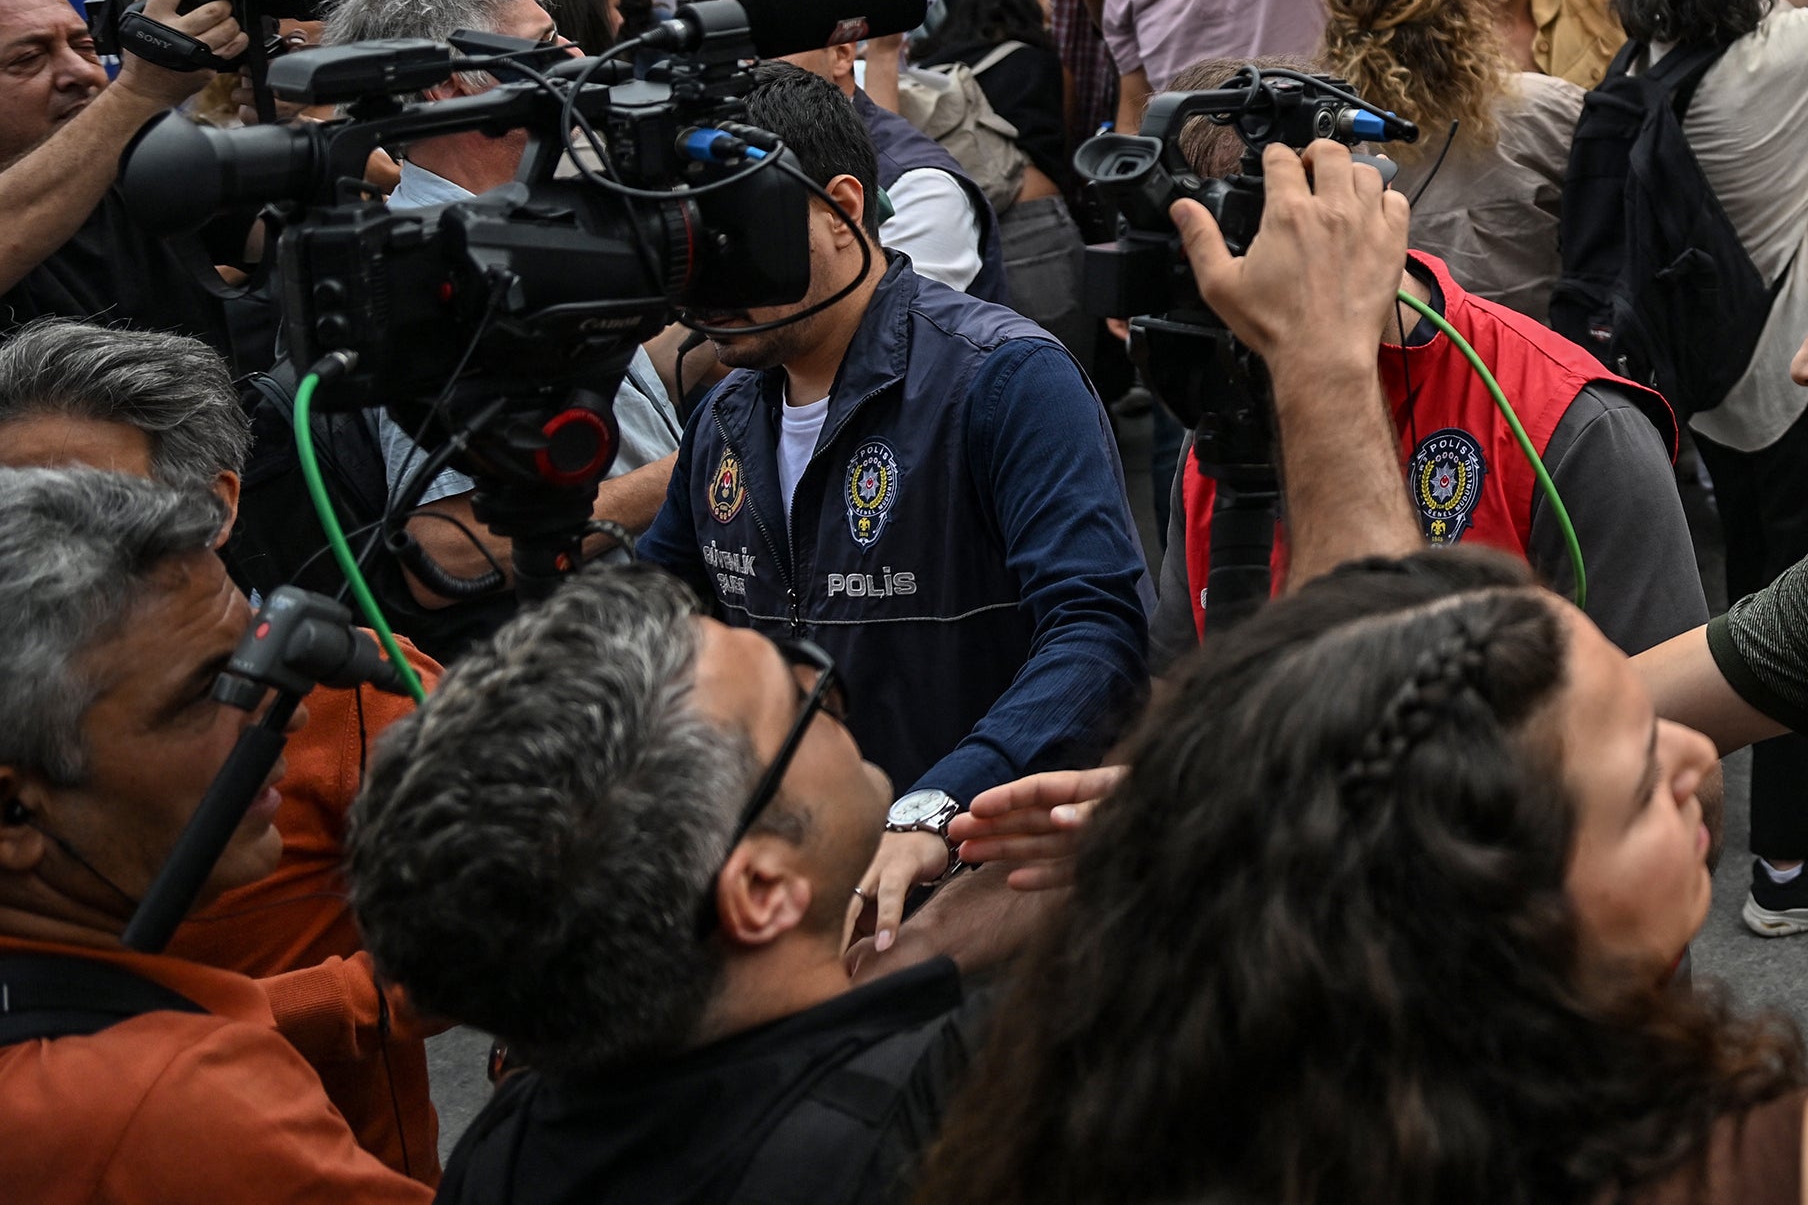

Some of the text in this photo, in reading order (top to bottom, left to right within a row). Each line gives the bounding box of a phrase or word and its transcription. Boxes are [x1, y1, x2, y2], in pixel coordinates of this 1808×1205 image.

[136, 30, 172, 49] SONY
[860, 446, 889, 461] POLİS
[1429, 439, 1468, 455] POLİS
[827, 566, 917, 598] POLİS
